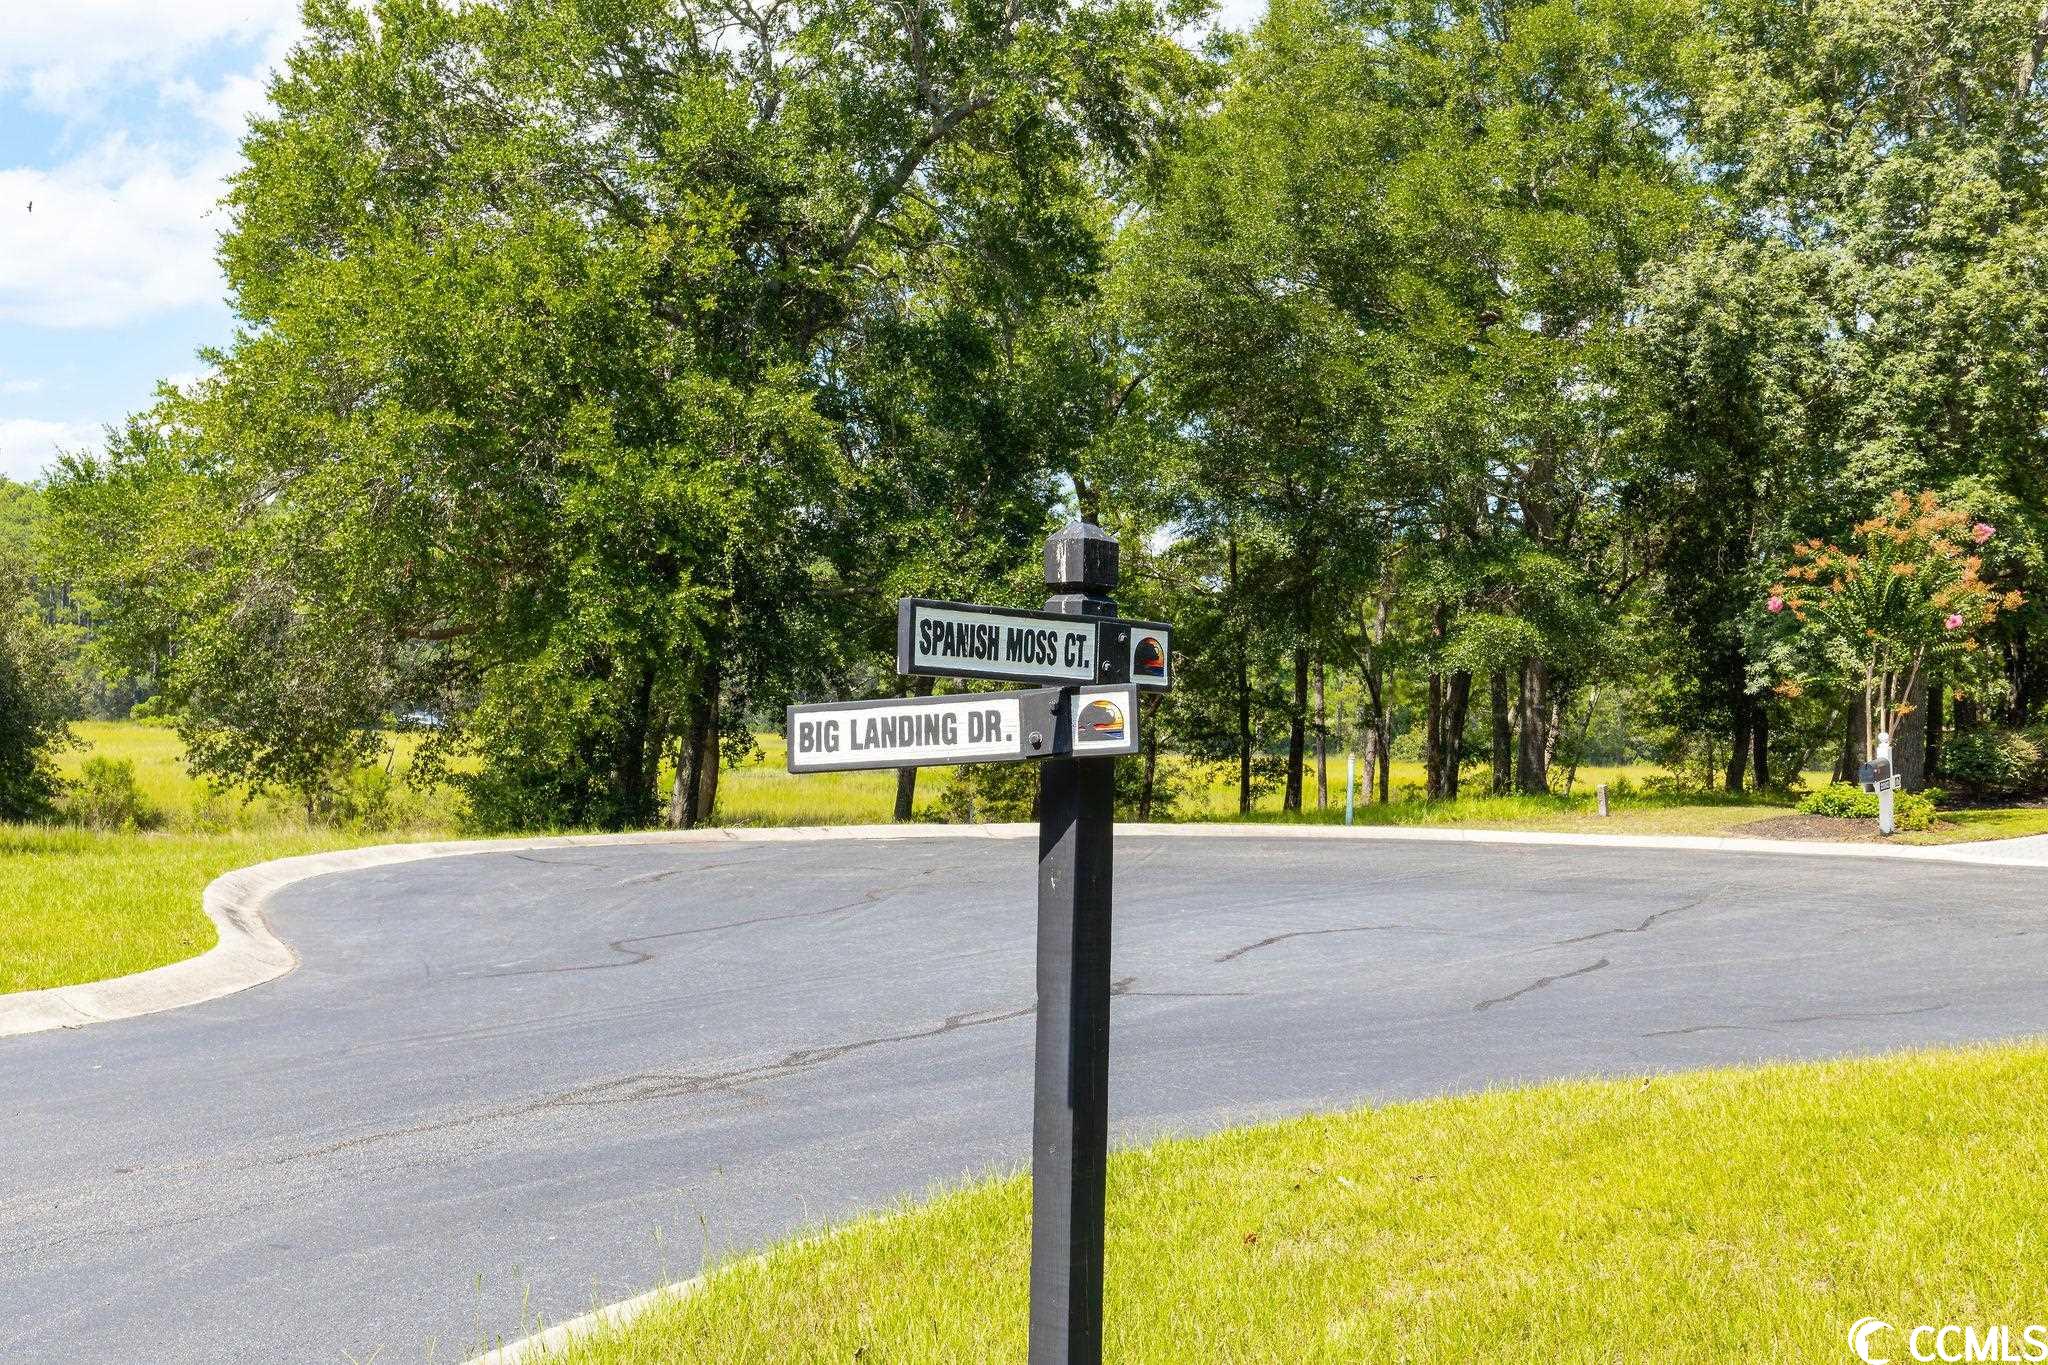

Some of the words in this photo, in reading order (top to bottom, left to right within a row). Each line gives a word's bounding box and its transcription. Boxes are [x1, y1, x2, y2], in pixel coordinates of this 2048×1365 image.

[919, 618, 1000, 661] SPANISH
[1006, 627, 1058, 666] MOSS
[1064, 632, 1090, 668] CT.
[799, 719, 840, 753] BIG
[850, 711, 958, 750] LANDING
[968, 710, 1012, 743] DR.
